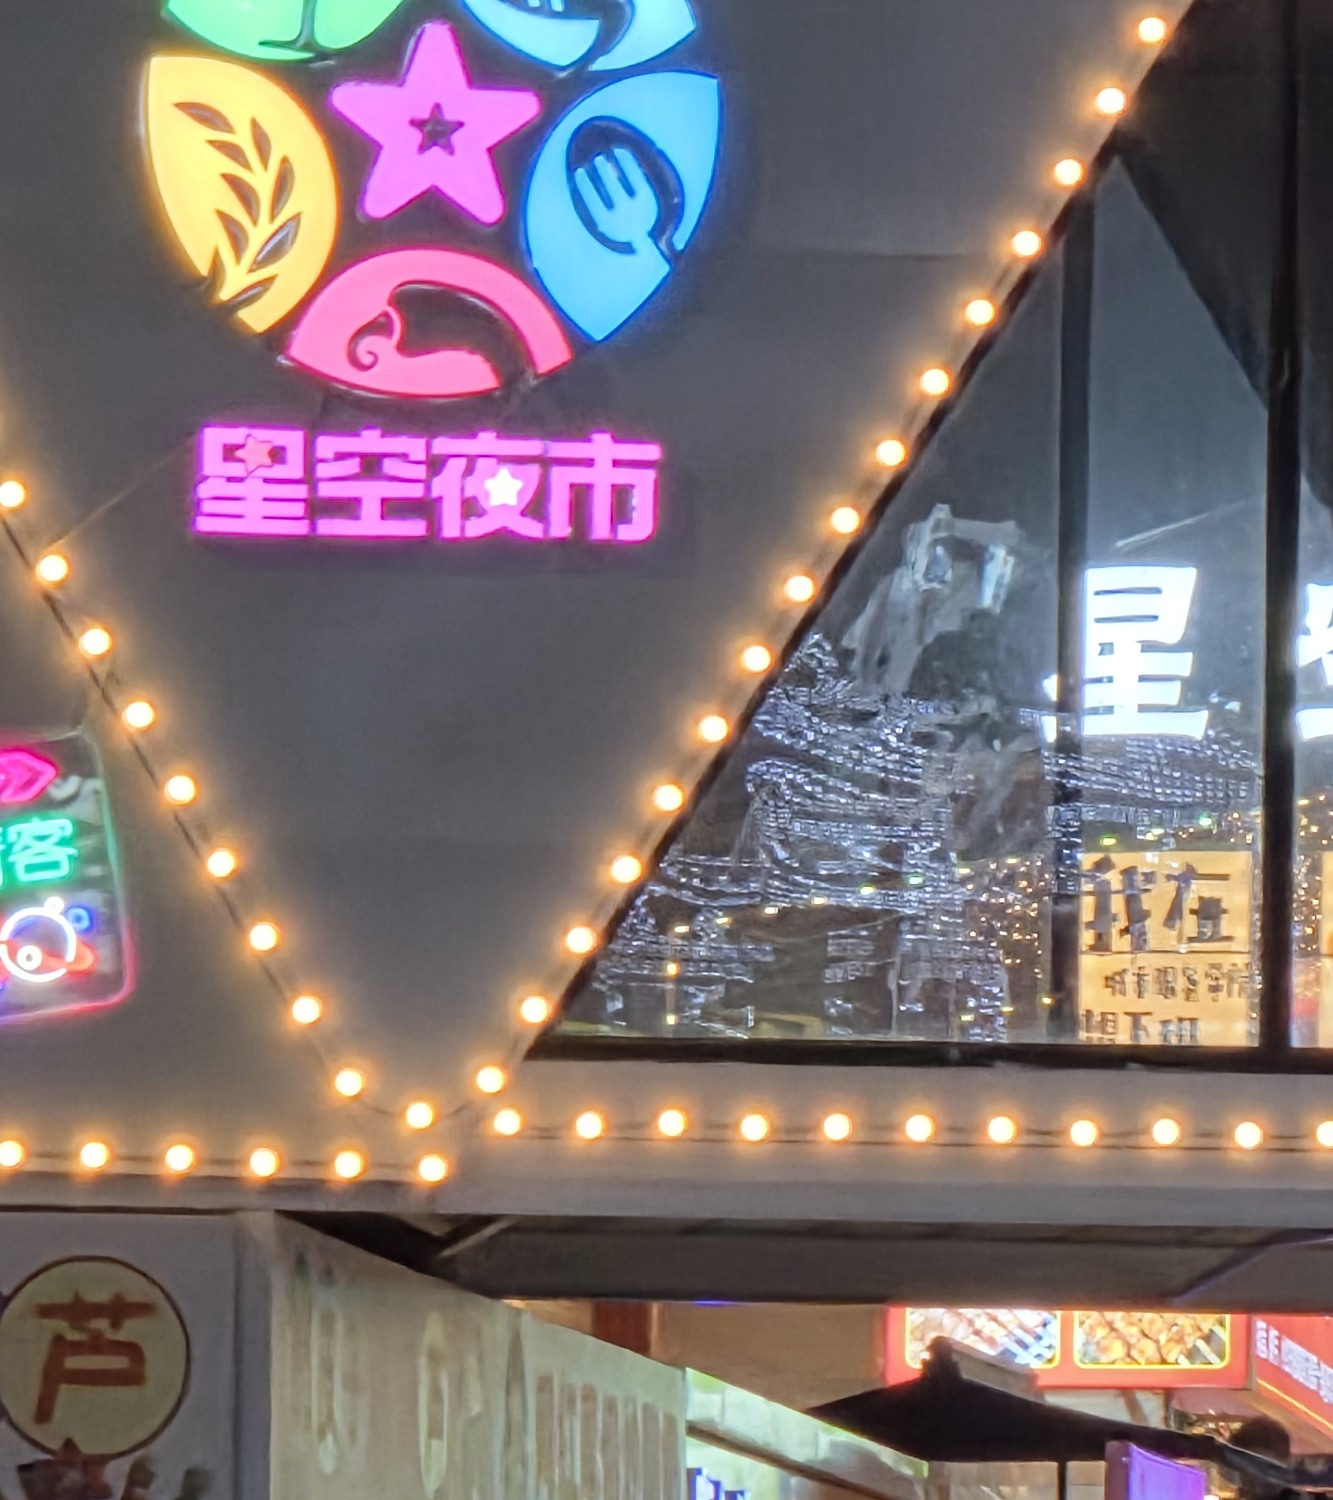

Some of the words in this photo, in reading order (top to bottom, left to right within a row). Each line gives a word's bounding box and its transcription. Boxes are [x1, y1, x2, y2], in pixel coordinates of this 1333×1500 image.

[193, 424, 662, 542] 星空夜市
[0, 816, 79, 886] 客
[33, 1290, 158, 1425] 芦
